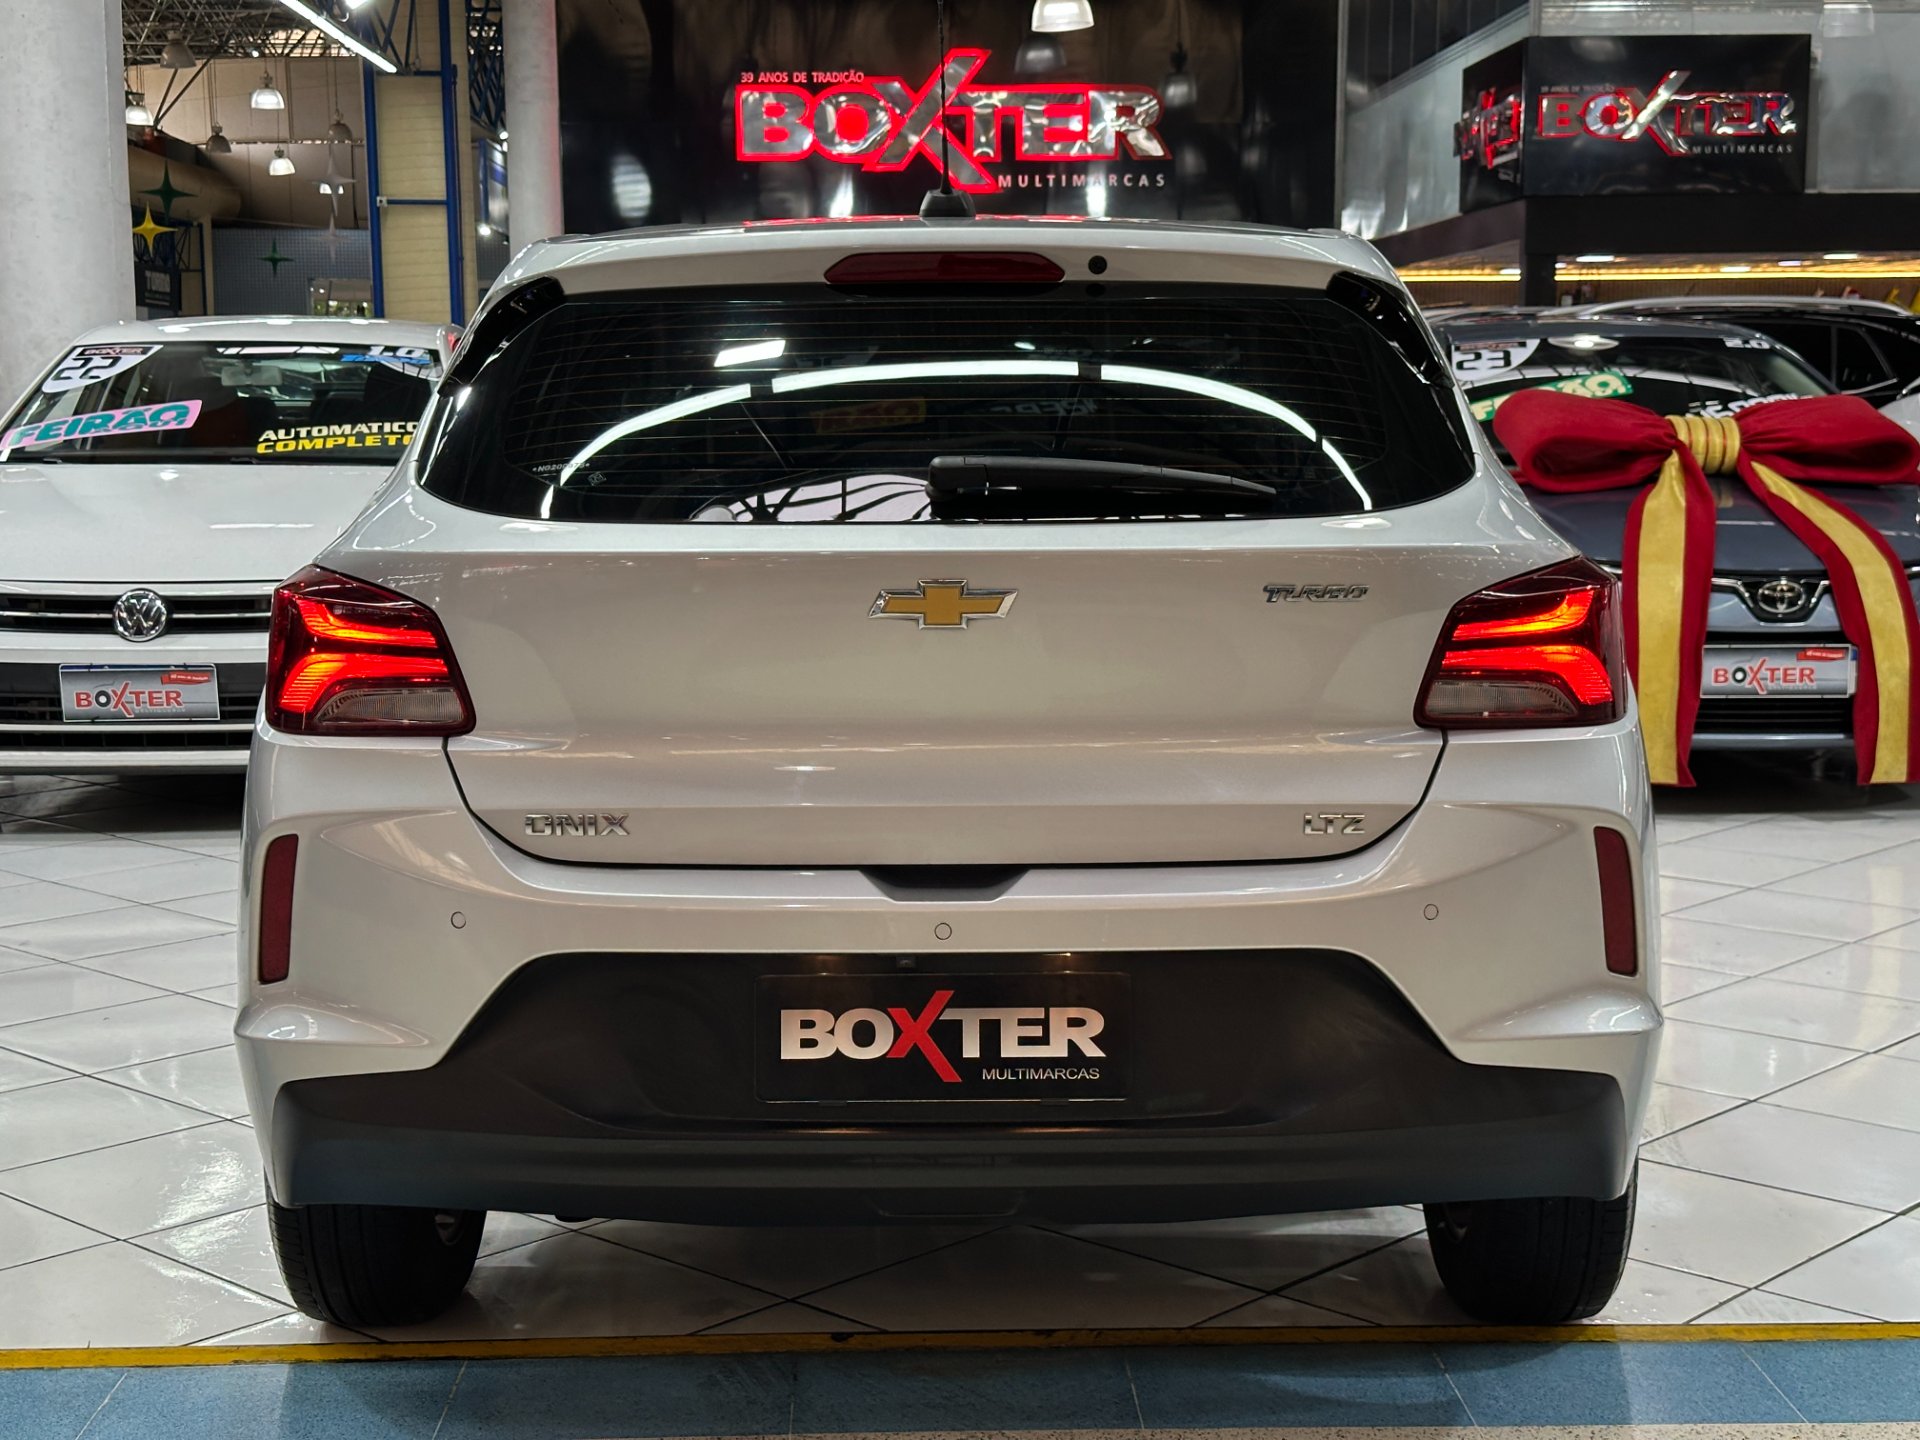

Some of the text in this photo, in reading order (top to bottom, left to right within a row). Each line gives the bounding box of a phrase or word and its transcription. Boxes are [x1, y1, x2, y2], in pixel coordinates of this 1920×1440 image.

[741, 69, 864, 84] 39 ANOS DE TRADIÇÃO
[736, 48, 1172, 192] BOXTER
[1538, 70, 1796, 156] BOXTER
[1692, 144, 1793, 154] MULTIMARCAS
[998, 174, 1165, 187] MULTIMARCAS
[51, 356, 122, 381] 22
[1456, 350, 1511, 371] 23
[9, 403, 190, 447] FEIRÃO
[1263, 584, 1369, 603] TURBO
[1712, 657, 1816, 695] BOXTER
[74, 681, 184, 717] BOXTER
[525, 814, 630, 837] ONIX
[1304, 814, 1366, 835] LTZ
[780, 989, 1107, 1083] BOXTER
[982, 1067, 1100, 1081] MULTIMARCAS
